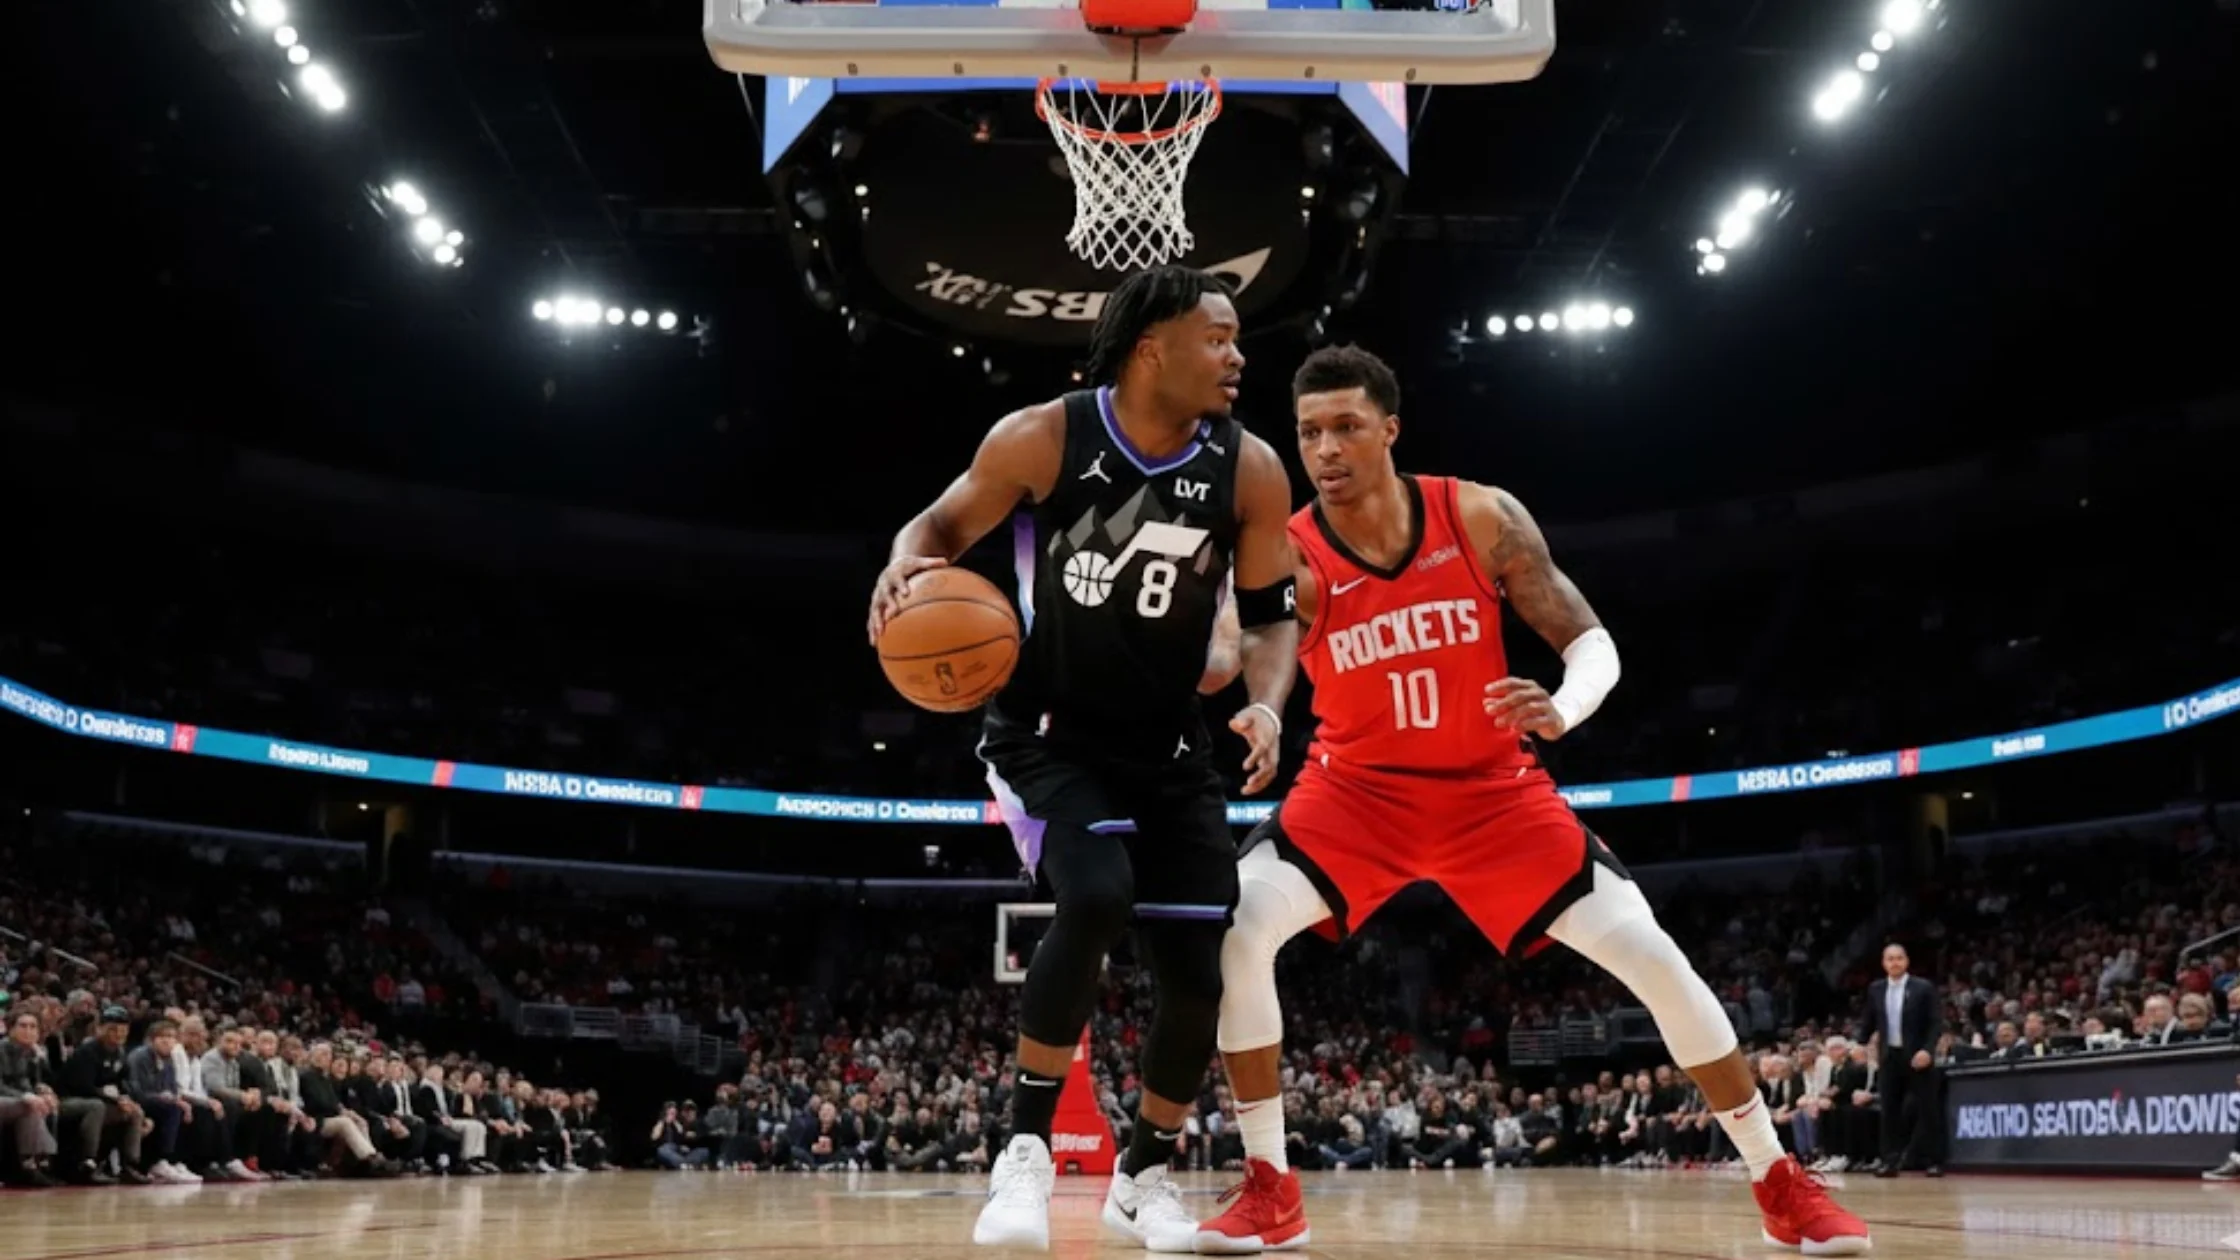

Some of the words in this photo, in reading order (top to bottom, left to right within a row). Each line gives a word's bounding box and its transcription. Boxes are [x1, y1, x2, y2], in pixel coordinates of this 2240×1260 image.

[1173, 477, 1211, 502] LVT
[1136, 559, 1178, 618] 8
[1327, 598, 1481, 674] ROCKETS
[1387, 667, 1439, 731] 10
